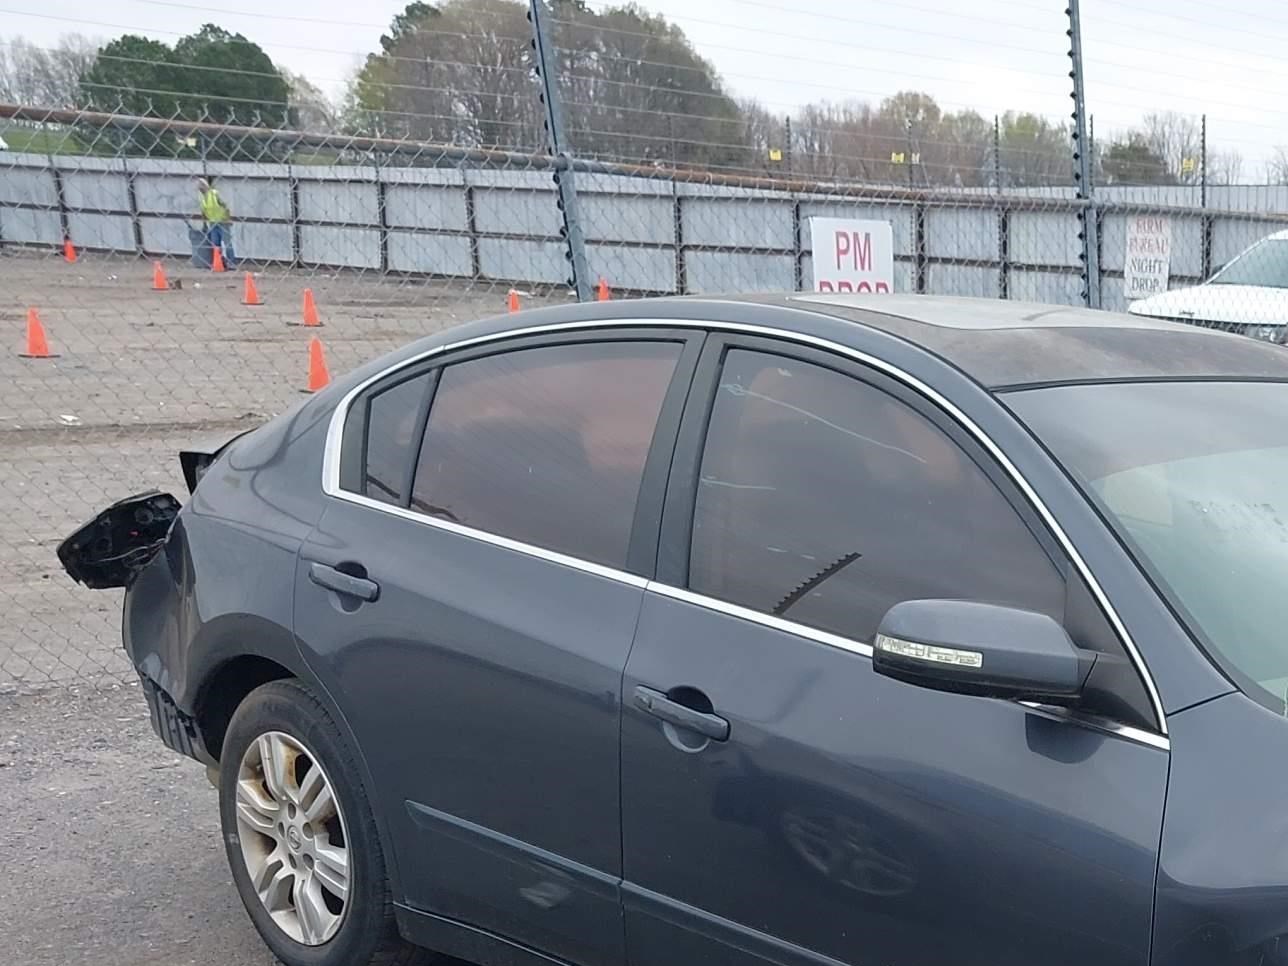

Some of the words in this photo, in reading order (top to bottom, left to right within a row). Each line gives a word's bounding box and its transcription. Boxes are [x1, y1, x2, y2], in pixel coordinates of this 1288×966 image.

[835, 231, 871, 271] PM
[1130, 258, 1163, 274] NIGHT
[1131, 277, 1160, 292] DROP
